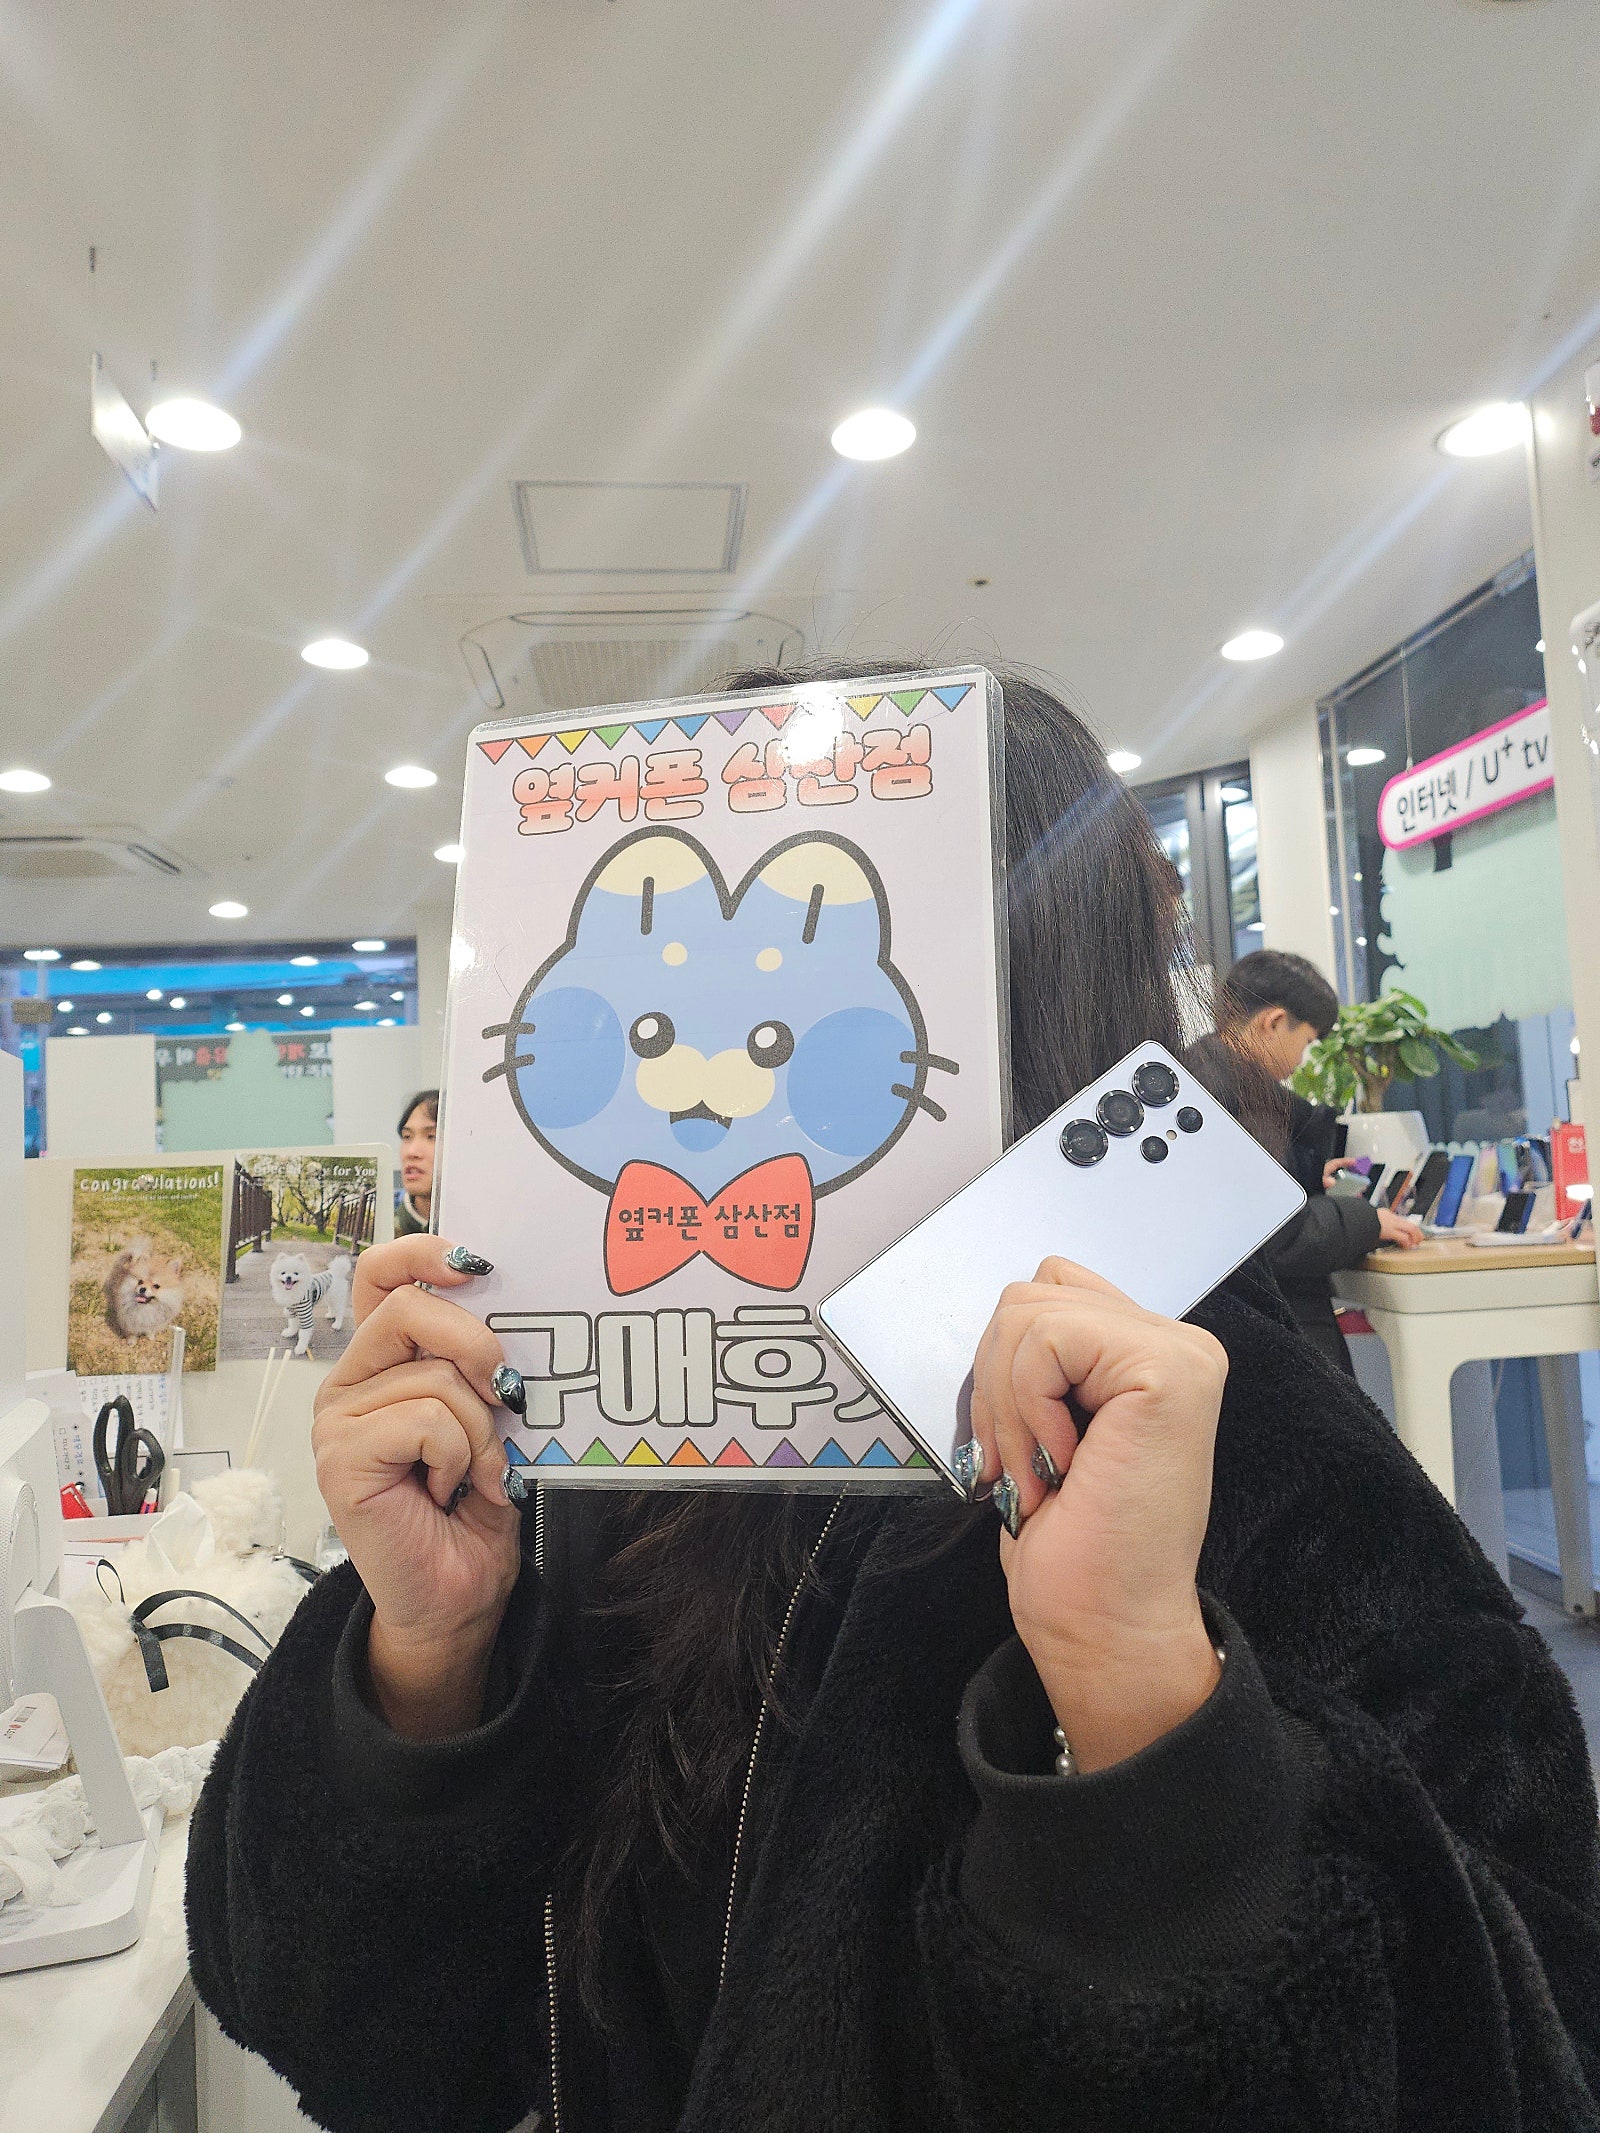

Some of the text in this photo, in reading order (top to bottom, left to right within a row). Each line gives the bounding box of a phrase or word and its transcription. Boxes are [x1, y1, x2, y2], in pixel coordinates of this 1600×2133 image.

[512, 723, 934, 836] 옆커폰 삼산점
[1397, 767, 1457, 832] 인터넷
[1464, 758, 1475, 801] /
[1522, 734, 1549, 769] tv
[618, 1203, 801, 1242] 옆커폰 삼산점
[485, 1303, 885, 1431] 구매후
